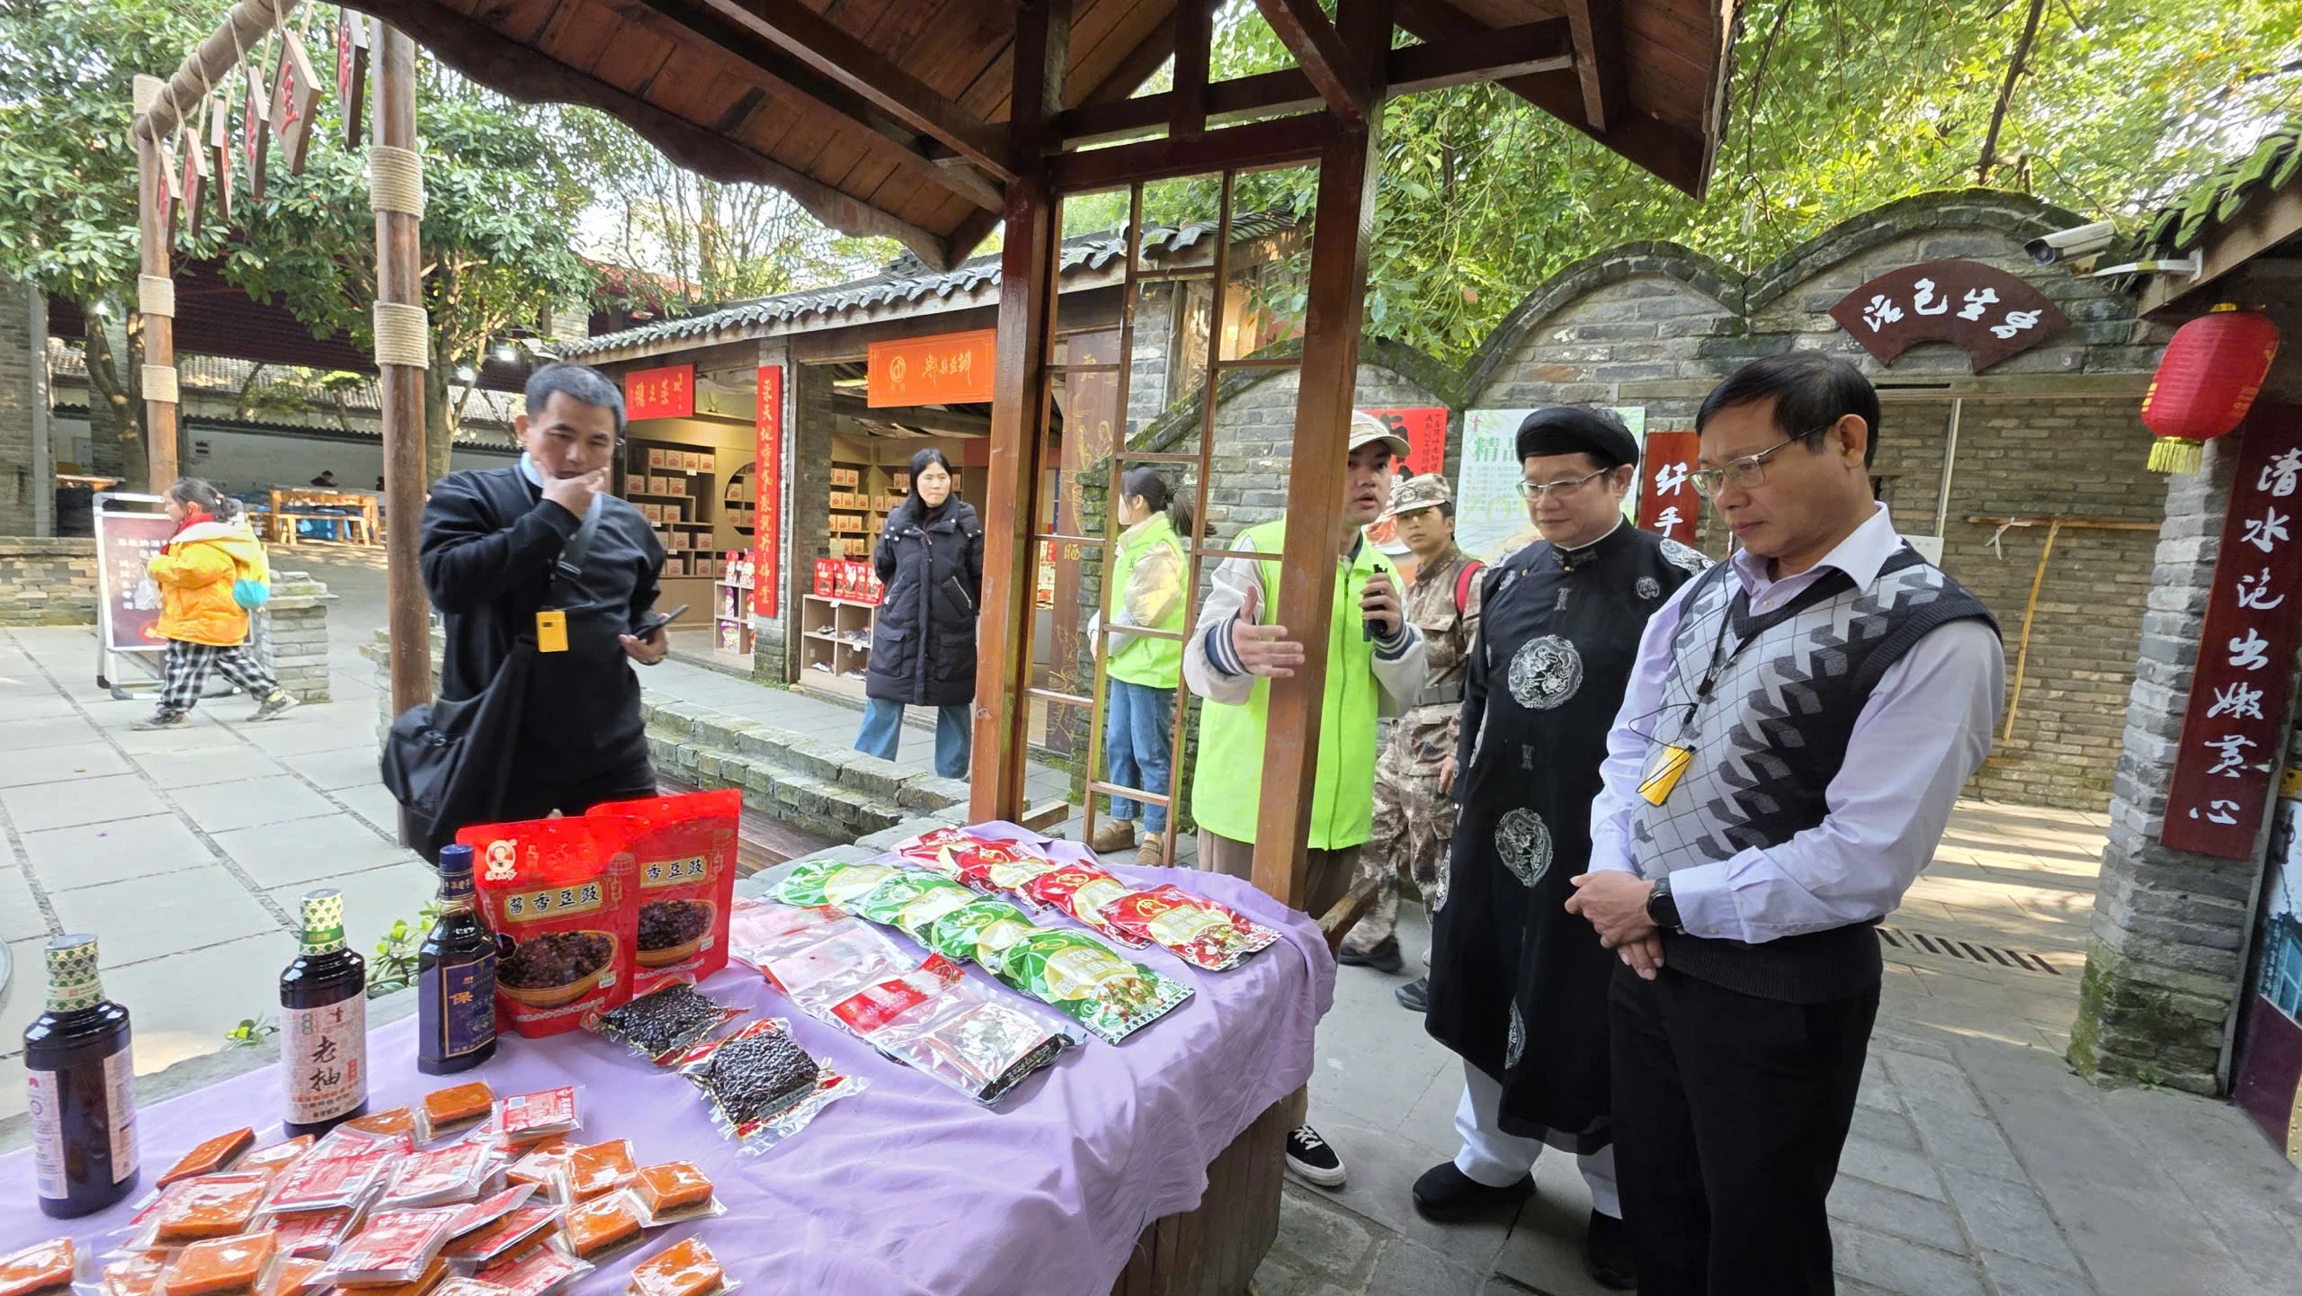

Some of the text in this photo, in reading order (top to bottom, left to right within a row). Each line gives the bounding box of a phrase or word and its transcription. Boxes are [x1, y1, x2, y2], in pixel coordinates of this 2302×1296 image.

[1654, 461, 1688, 537] 纤手
[508, 885, 600, 914] 酱香豆豉
[310, 1036, 341, 1091] 老抽
